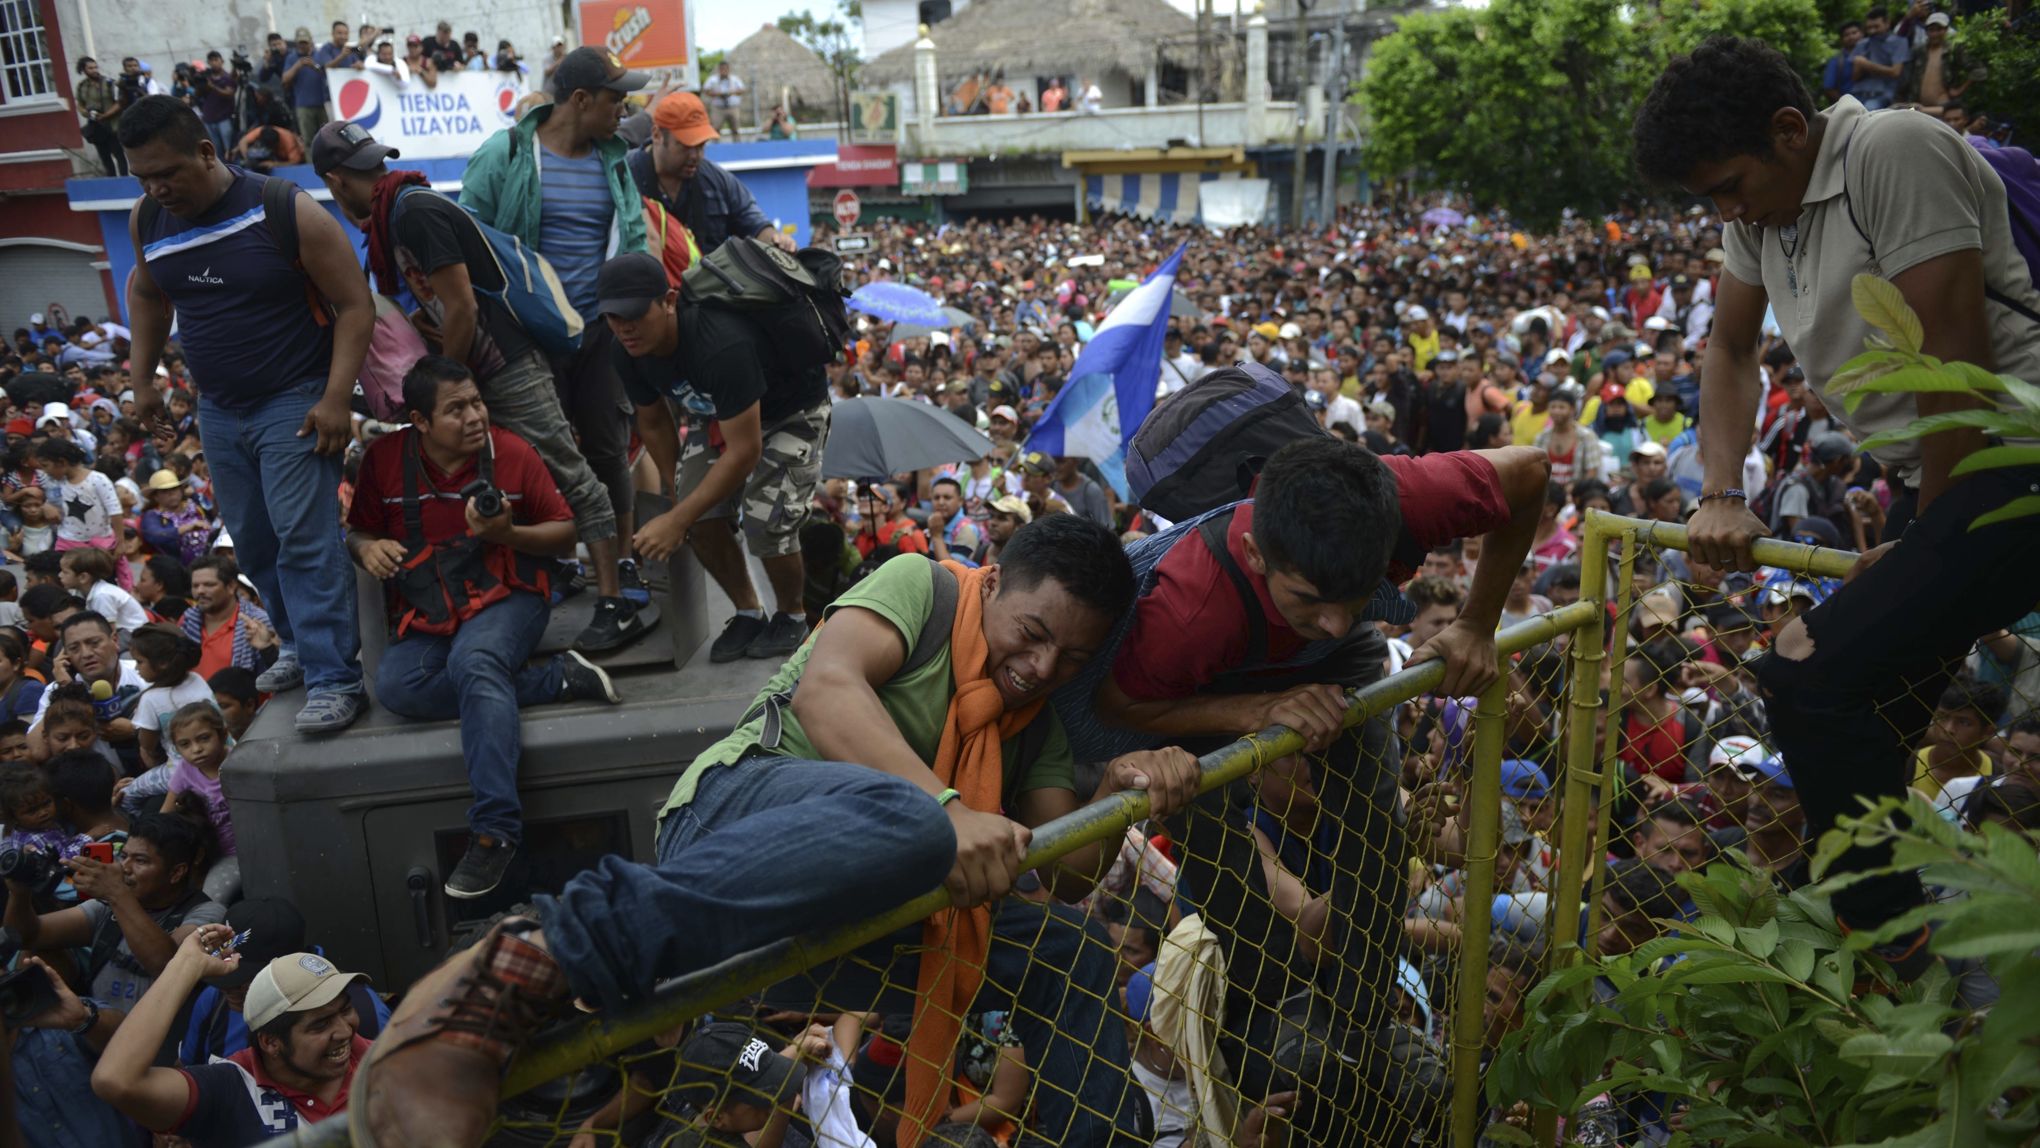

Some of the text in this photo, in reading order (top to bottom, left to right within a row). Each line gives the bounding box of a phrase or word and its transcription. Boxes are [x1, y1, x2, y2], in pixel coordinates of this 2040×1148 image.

[605, 6, 652, 55] Crush
[398, 94, 470, 112] TIENDA
[401, 116, 483, 135] LIZAYDA
[836, 200, 859, 216] ALTO
[188, 275, 224, 284] NAUTICA
